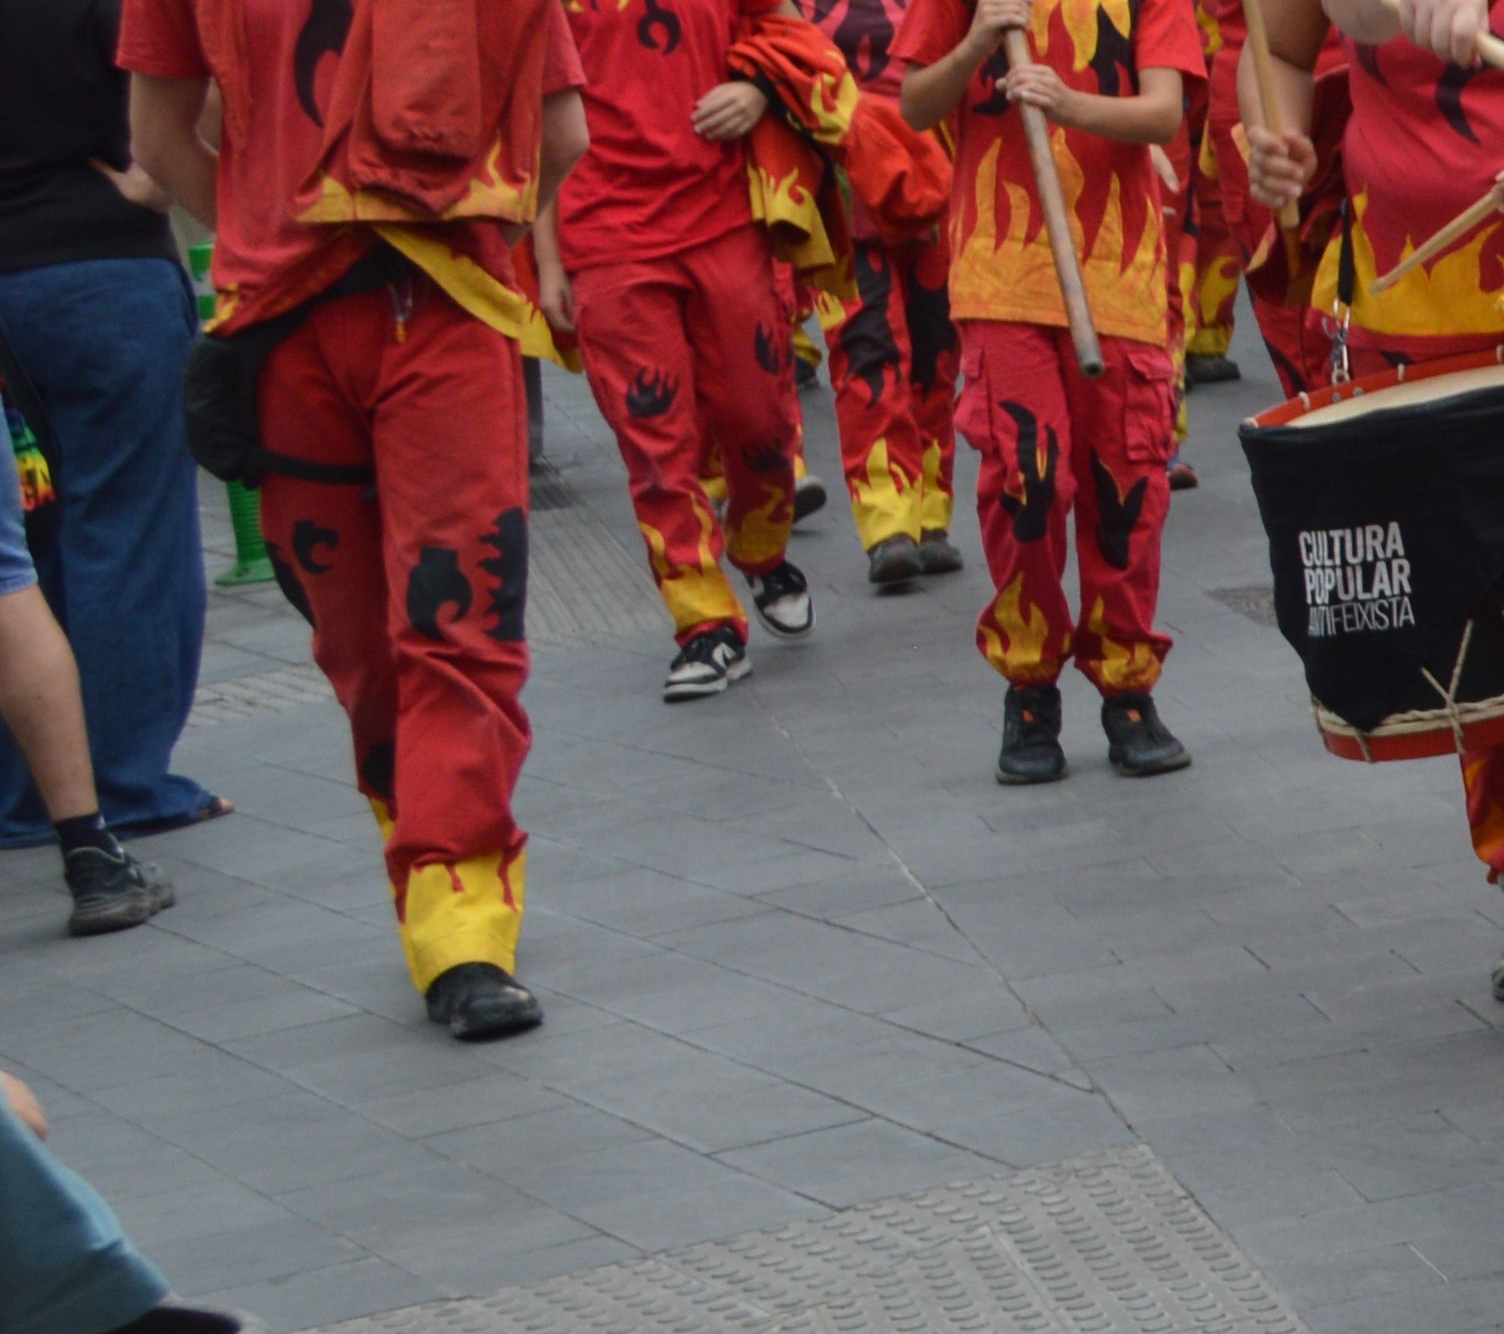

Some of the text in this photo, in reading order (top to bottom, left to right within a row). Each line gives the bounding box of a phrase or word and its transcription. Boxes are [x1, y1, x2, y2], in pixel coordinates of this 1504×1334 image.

[1298, 521, 1405, 567] CULTURA
[1304, 558, 1412, 605] POPULAR
[1308, 596, 1416, 637] ANTIFEIXISTA
